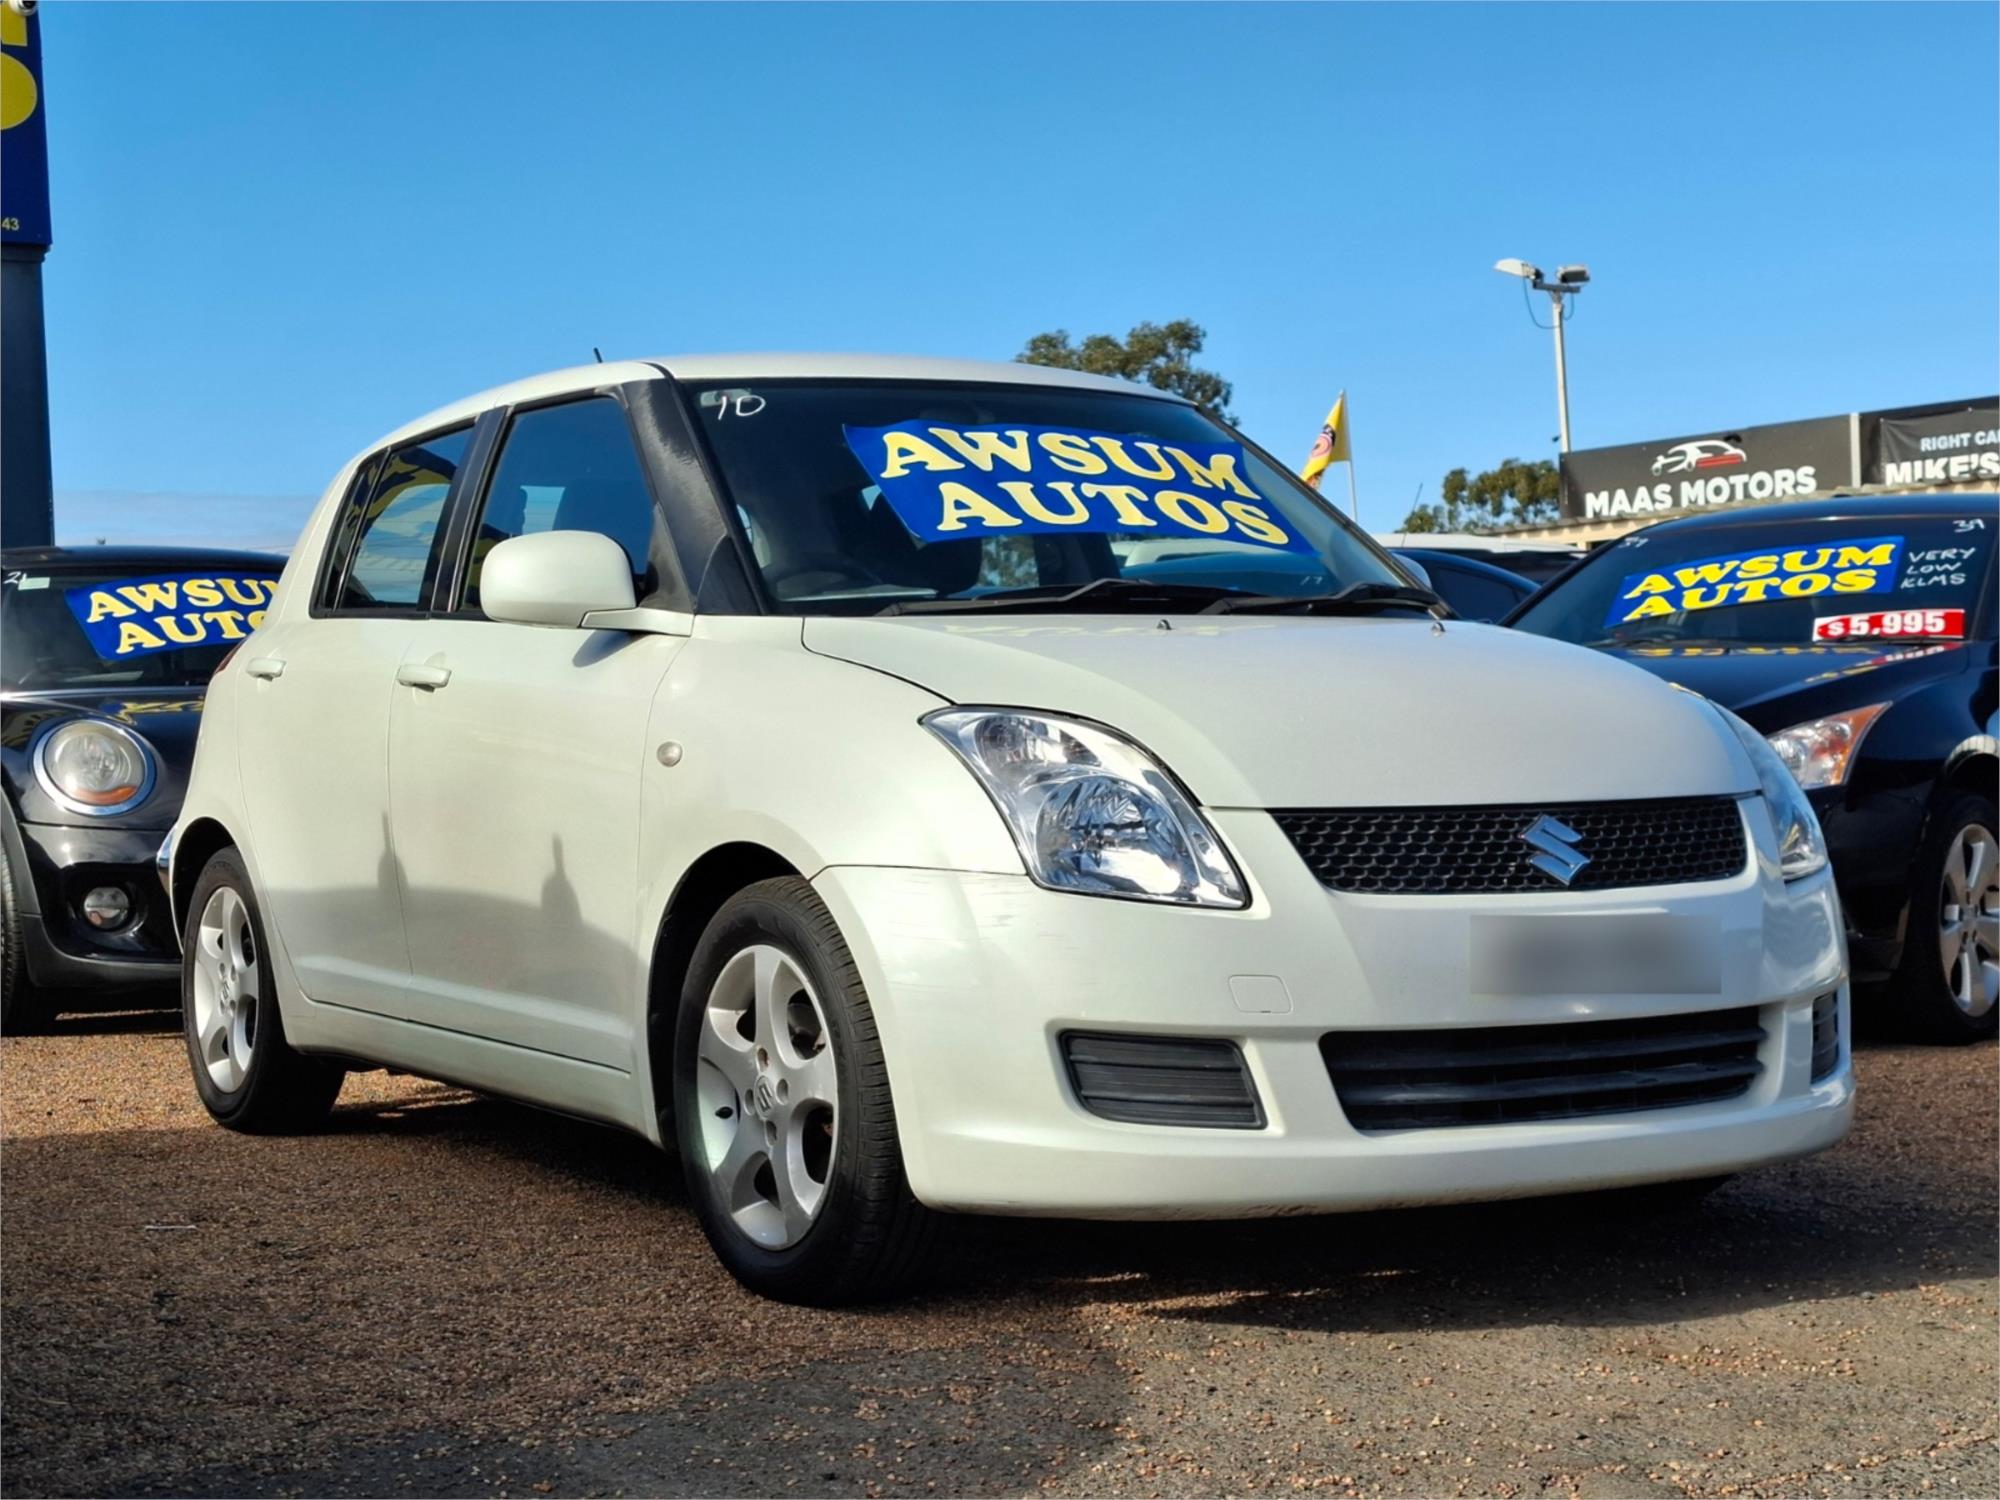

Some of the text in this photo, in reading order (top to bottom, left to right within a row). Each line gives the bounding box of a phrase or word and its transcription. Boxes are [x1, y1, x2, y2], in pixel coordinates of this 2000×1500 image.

[880, 427, 1262, 500] AWSUM
[1921, 429, 1999, 452] RIGHT CA
[936, 481, 1290, 545] AUTOS
[1585, 466, 1818, 519] MAAS MOTORS
[1623, 543, 1897, 600] AWSUM
[1906, 562, 1962, 575] LOW
[1908, 547, 1977, 563] VERY
[1623, 569, 1877, 622] AUTOS
